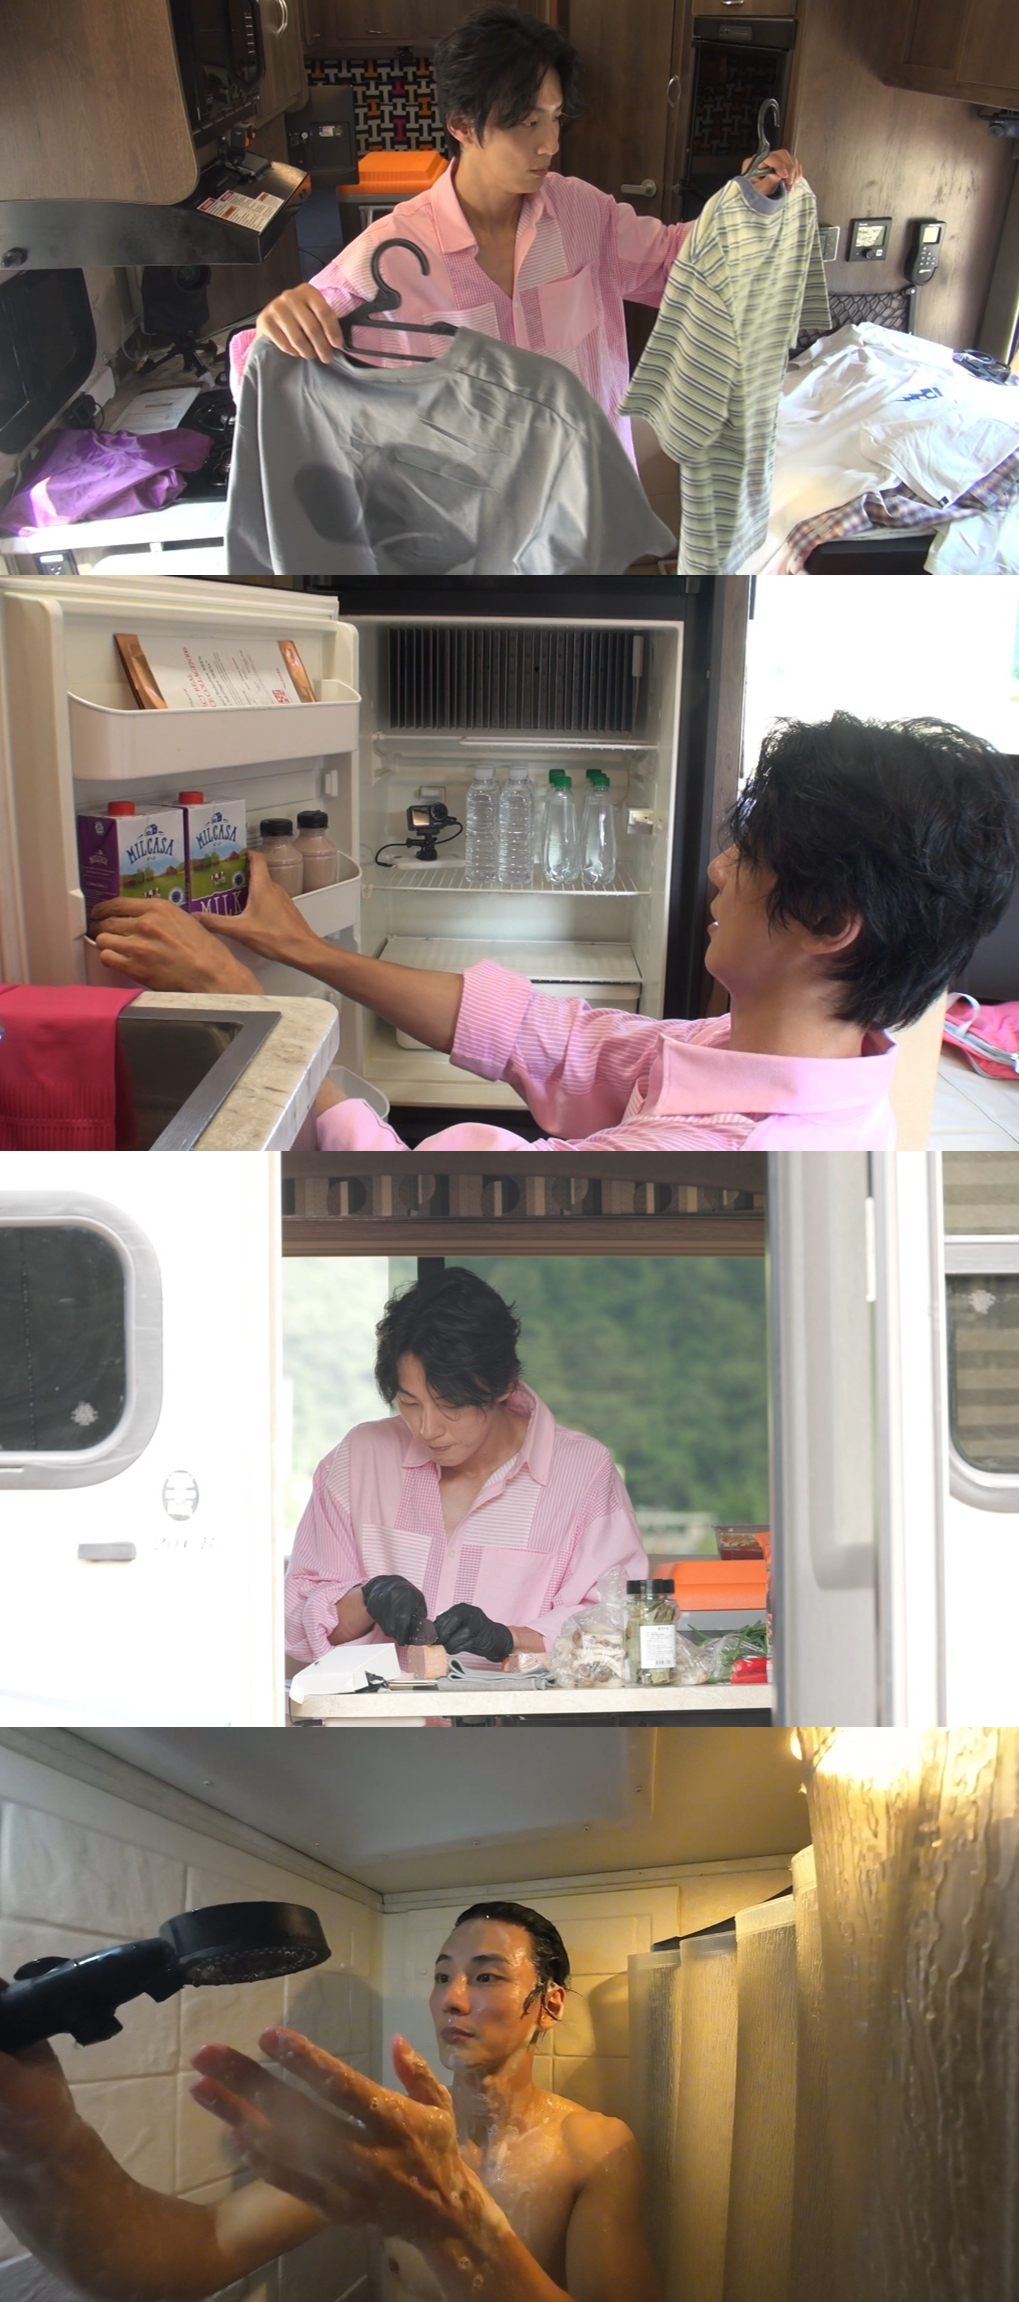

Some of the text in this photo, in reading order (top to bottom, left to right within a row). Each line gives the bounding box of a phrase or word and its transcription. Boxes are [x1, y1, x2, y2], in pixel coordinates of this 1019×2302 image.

[196, 824, 238, 850] MILCASA
[126, 837, 175, 865] MILCASA
[200, 890, 242, 916] MILK
